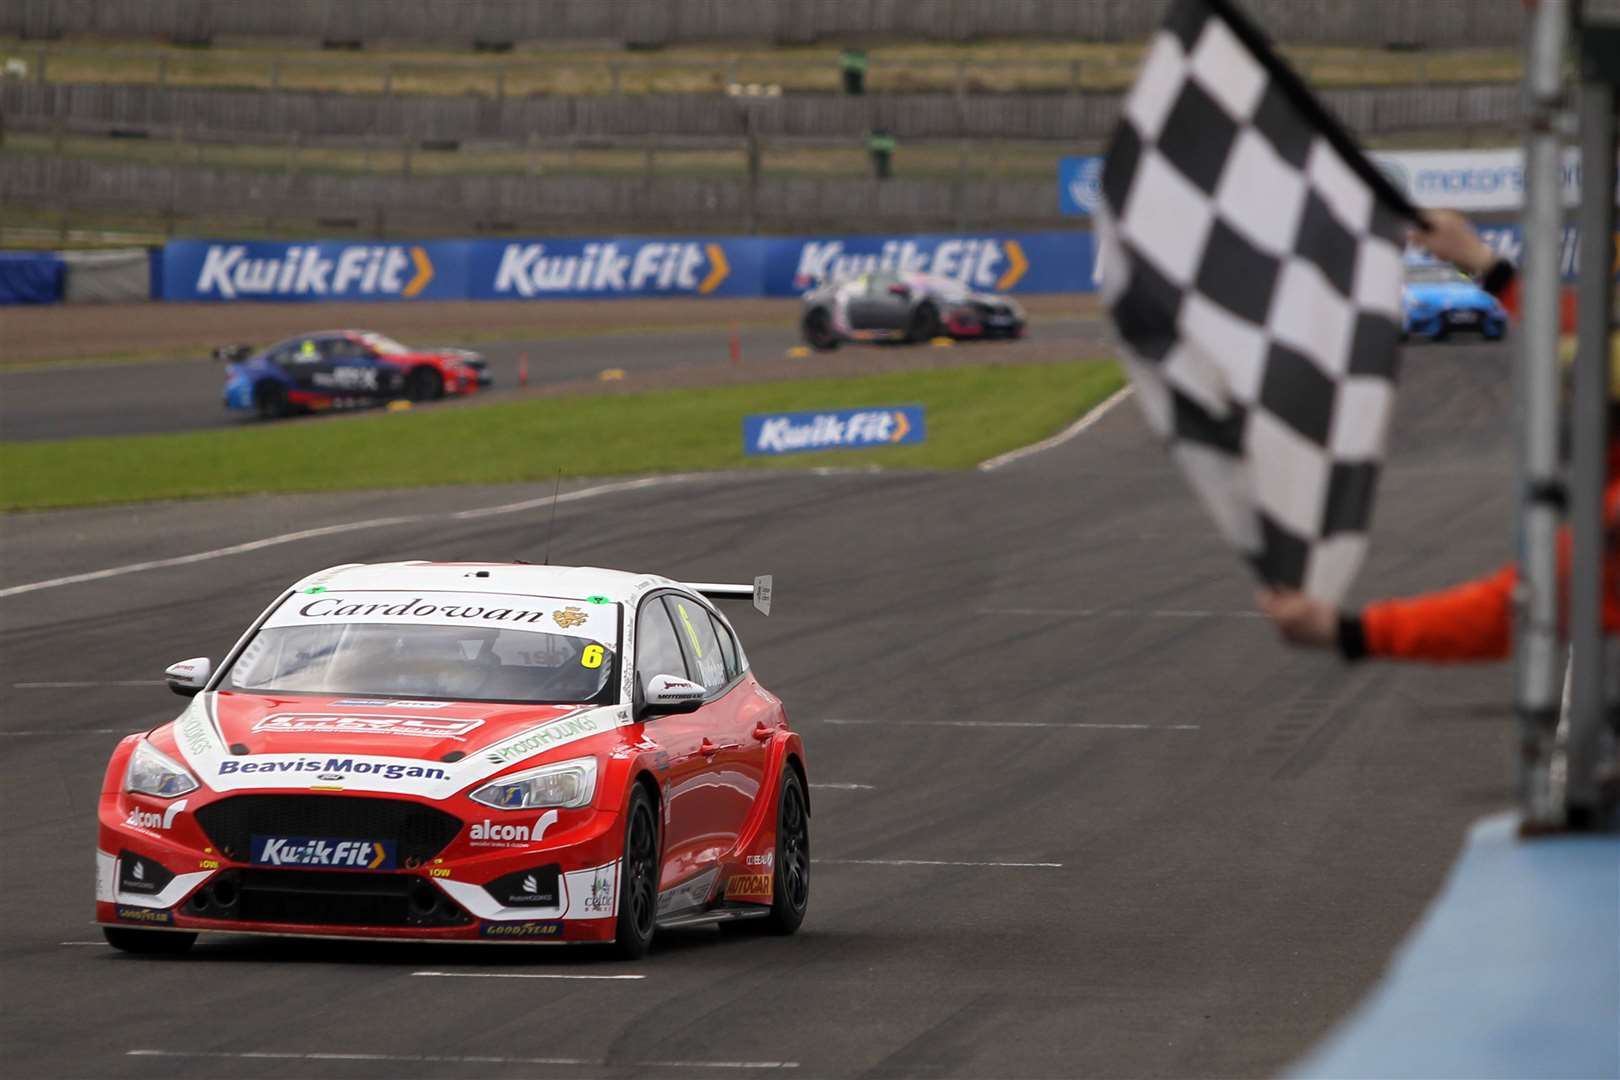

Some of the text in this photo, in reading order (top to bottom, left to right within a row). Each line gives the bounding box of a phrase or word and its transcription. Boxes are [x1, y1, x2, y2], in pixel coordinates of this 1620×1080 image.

[300, 598, 544, 623] Cardowan
[582, 645, 604, 668] 6
[125, 806, 162, 829] alcon
[469, 819, 530, 841] alcon
[727, 874, 770, 894] AUTOCAR
[487, 922, 557, 935] GOODYEAR
